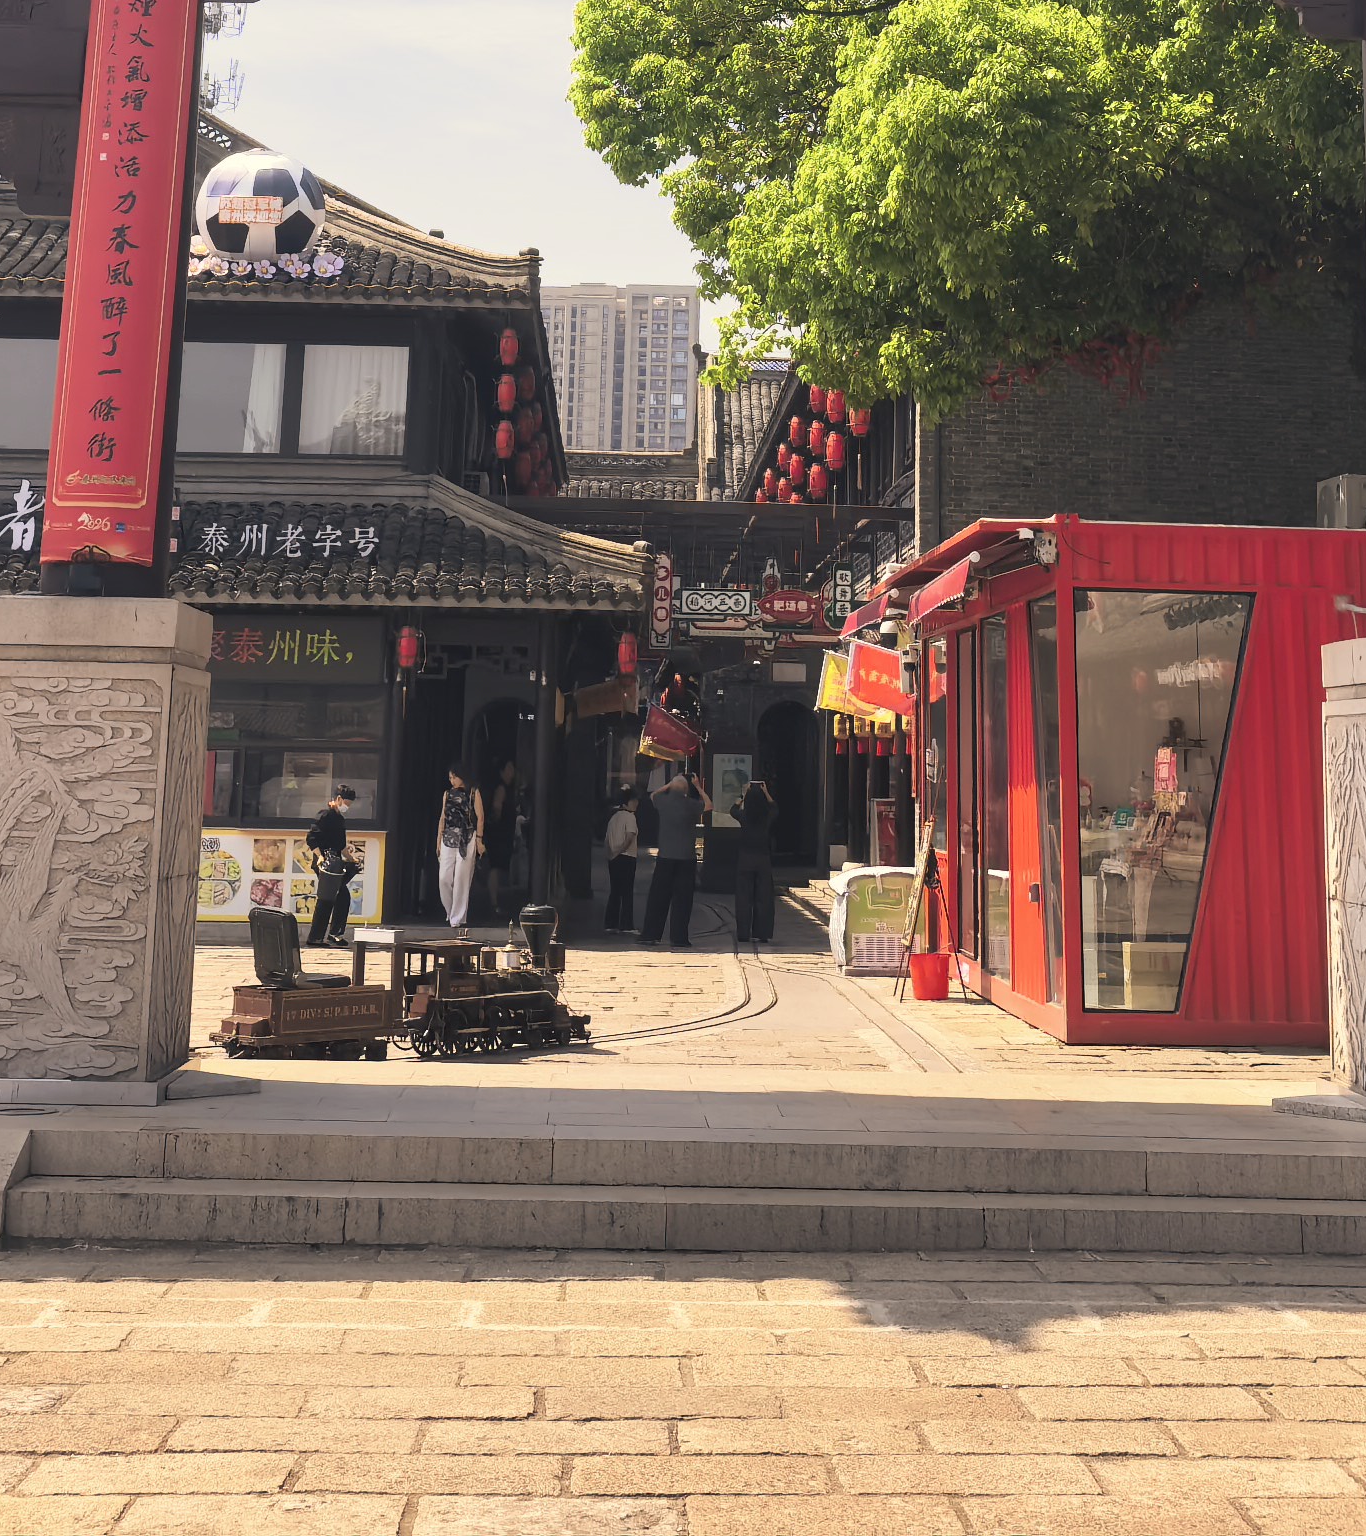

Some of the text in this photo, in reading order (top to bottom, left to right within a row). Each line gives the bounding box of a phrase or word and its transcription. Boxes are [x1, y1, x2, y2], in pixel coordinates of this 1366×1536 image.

[197, 522, 380, 558] 泰州老字号
